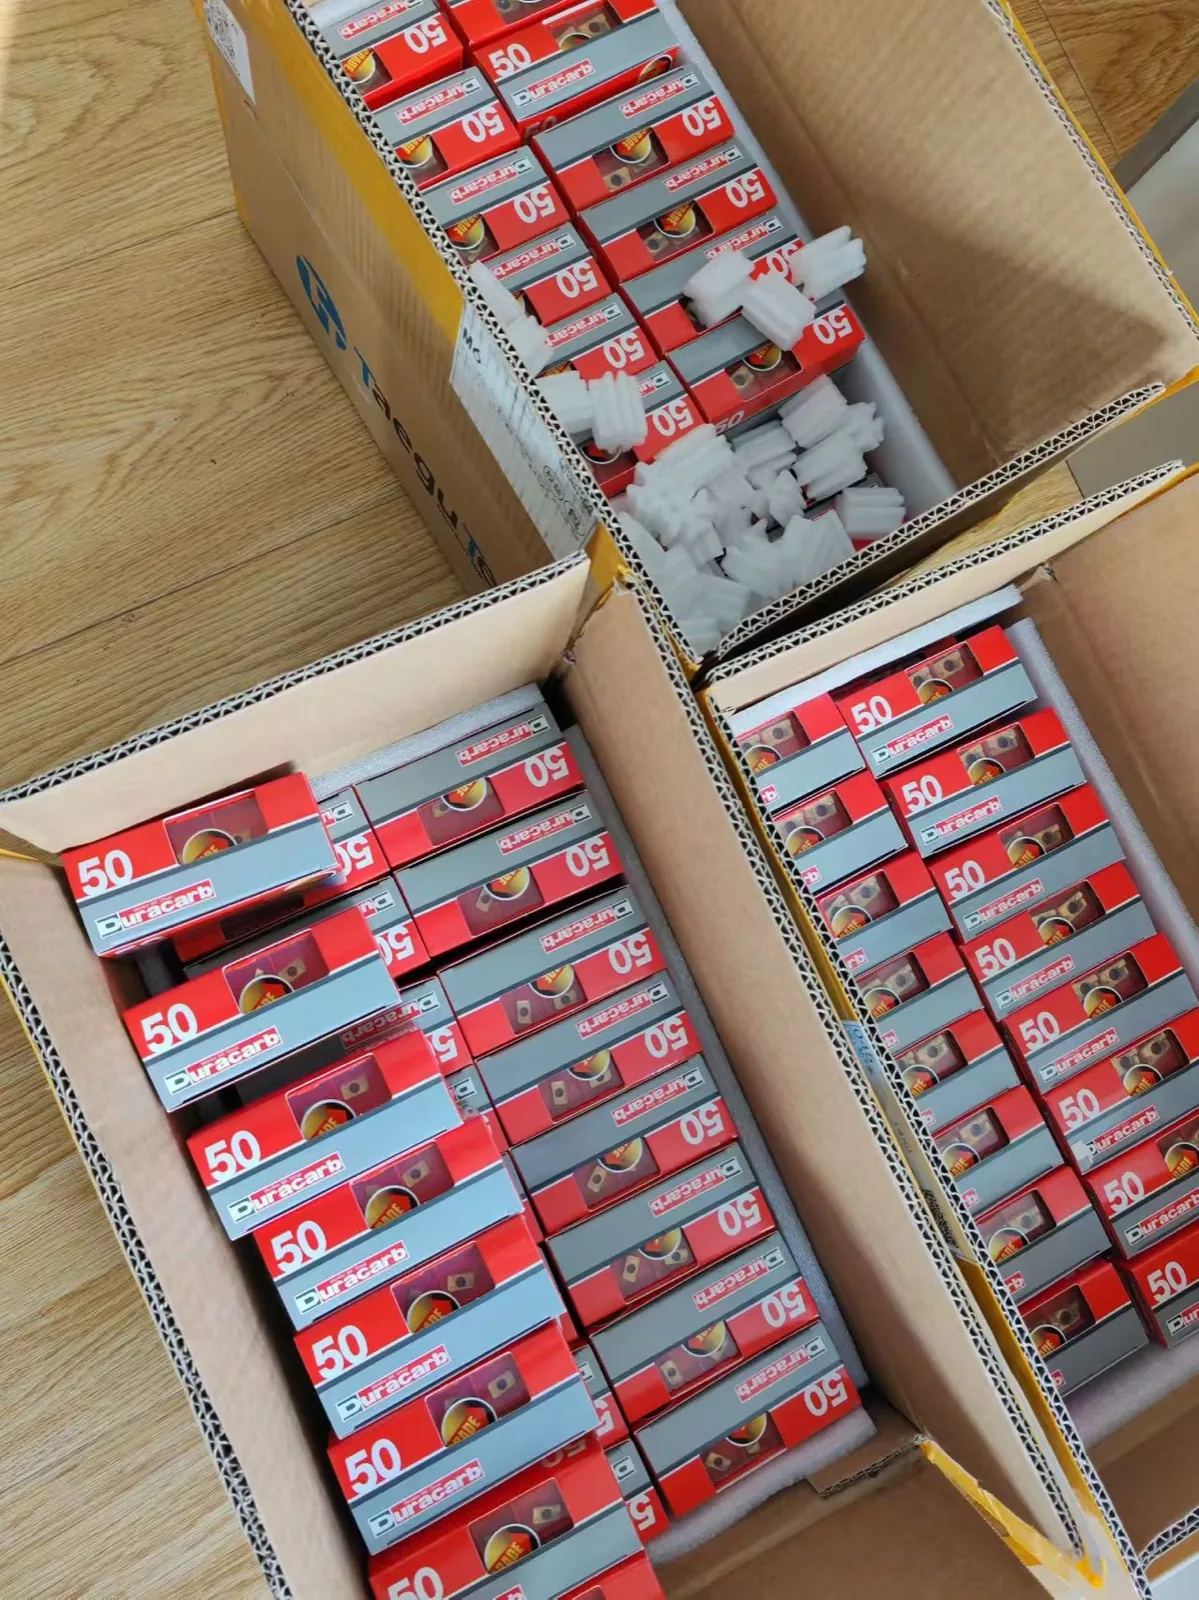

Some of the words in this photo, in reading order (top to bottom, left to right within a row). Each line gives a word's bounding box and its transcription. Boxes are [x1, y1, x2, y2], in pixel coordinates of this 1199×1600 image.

[403, 18, 448, 53] 50
[488, 43, 531, 78] 50
[397, 77, 480, 123] Duracarb
[512, 59, 595, 108] Duracarb
[619, 73, 699, 119] Duracarb
[462, 105, 504, 142] 50
[682, 100, 722, 136] 50
[450, 157, 534, 203] Duracarb
[663, 145, 743, 192] Duracarb
[726, 172, 765, 208] 50
[514, 187, 556, 223] 50
[491, 234, 576, 279] Duracarb
[556, 261, 598, 298] 50
[545, 303, 622, 347] Duracar
[812, 310, 852, 344] 50
[603, 331, 645, 369] 50
[653, 400, 694, 437] 50
[354, 347, 498, 588] TaeguTe
[851, 696, 891, 734] 50
[455, 715, 549, 767] Duracarb
[872, 714, 952, 764] Duracarb
[525, 749, 568, 788] 50
[903, 775, 943, 812] 50
[497, 804, 591, 855] Duracarb
[920, 796, 1002, 845] Duracarb
[77, 850, 132, 896] 50
[566, 839, 610, 877] 50
[945, 861, 985, 898] 50
[95, 880, 217, 938] Duracarb
[540, 899, 634, 953] Duracarb
[963, 878, 1044, 932] Duracarb
[608, 934, 652, 974] 50
[975, 938, 1015, 977] 50
[996, 955, 1076, 1009] Duracarb
[142, 1003, 198, 1053] 50
[576, 982, 669, 1040] Duracarb
[1019, 1012, 1058, 1049] 50
[165, 1025, 283, 1094] Duracarb
[431, 1027, 457, 1063] 5
[645, 1018, 688, 1058] 50
[1039, 1028, 1120, 1083] Duracarb
[610, 1068, 704, 1127] Duracarb
[1060, 1088, 1099, 1128] 50
[681, 1105, 724, 1145] 50
[204, 1130, 261, 1180] 50
[227, 1151, 346, 1223] Duracarb
[648, 1157, 742, 1217] Duracarb
[1104, 1172, 1144, 1213] 50
[718, 1196, 761, 1236] 50
[271, 1220, 326, 1271] 50
[294, 1240, 410, 1314] Duracarb
[692, 1247, 785, 1312] Duracarb
[1147, 1261, 1187, 1302] 50
[761, 1287, 806, 1328] 50
[312, 1325, 367, 1378] 50
[735, 1336, 827, 1403] Duracarb
[336, 1344, 451, 1422] Duracarb
[804, 1373, 848, 1416] 50
[345, 1439, 401, 1493] 50
[368, 1458, 485, 1538] Duracarb
[628, 1494, 655, 1531] 5
[388, 1566, 443, 1600] 50
